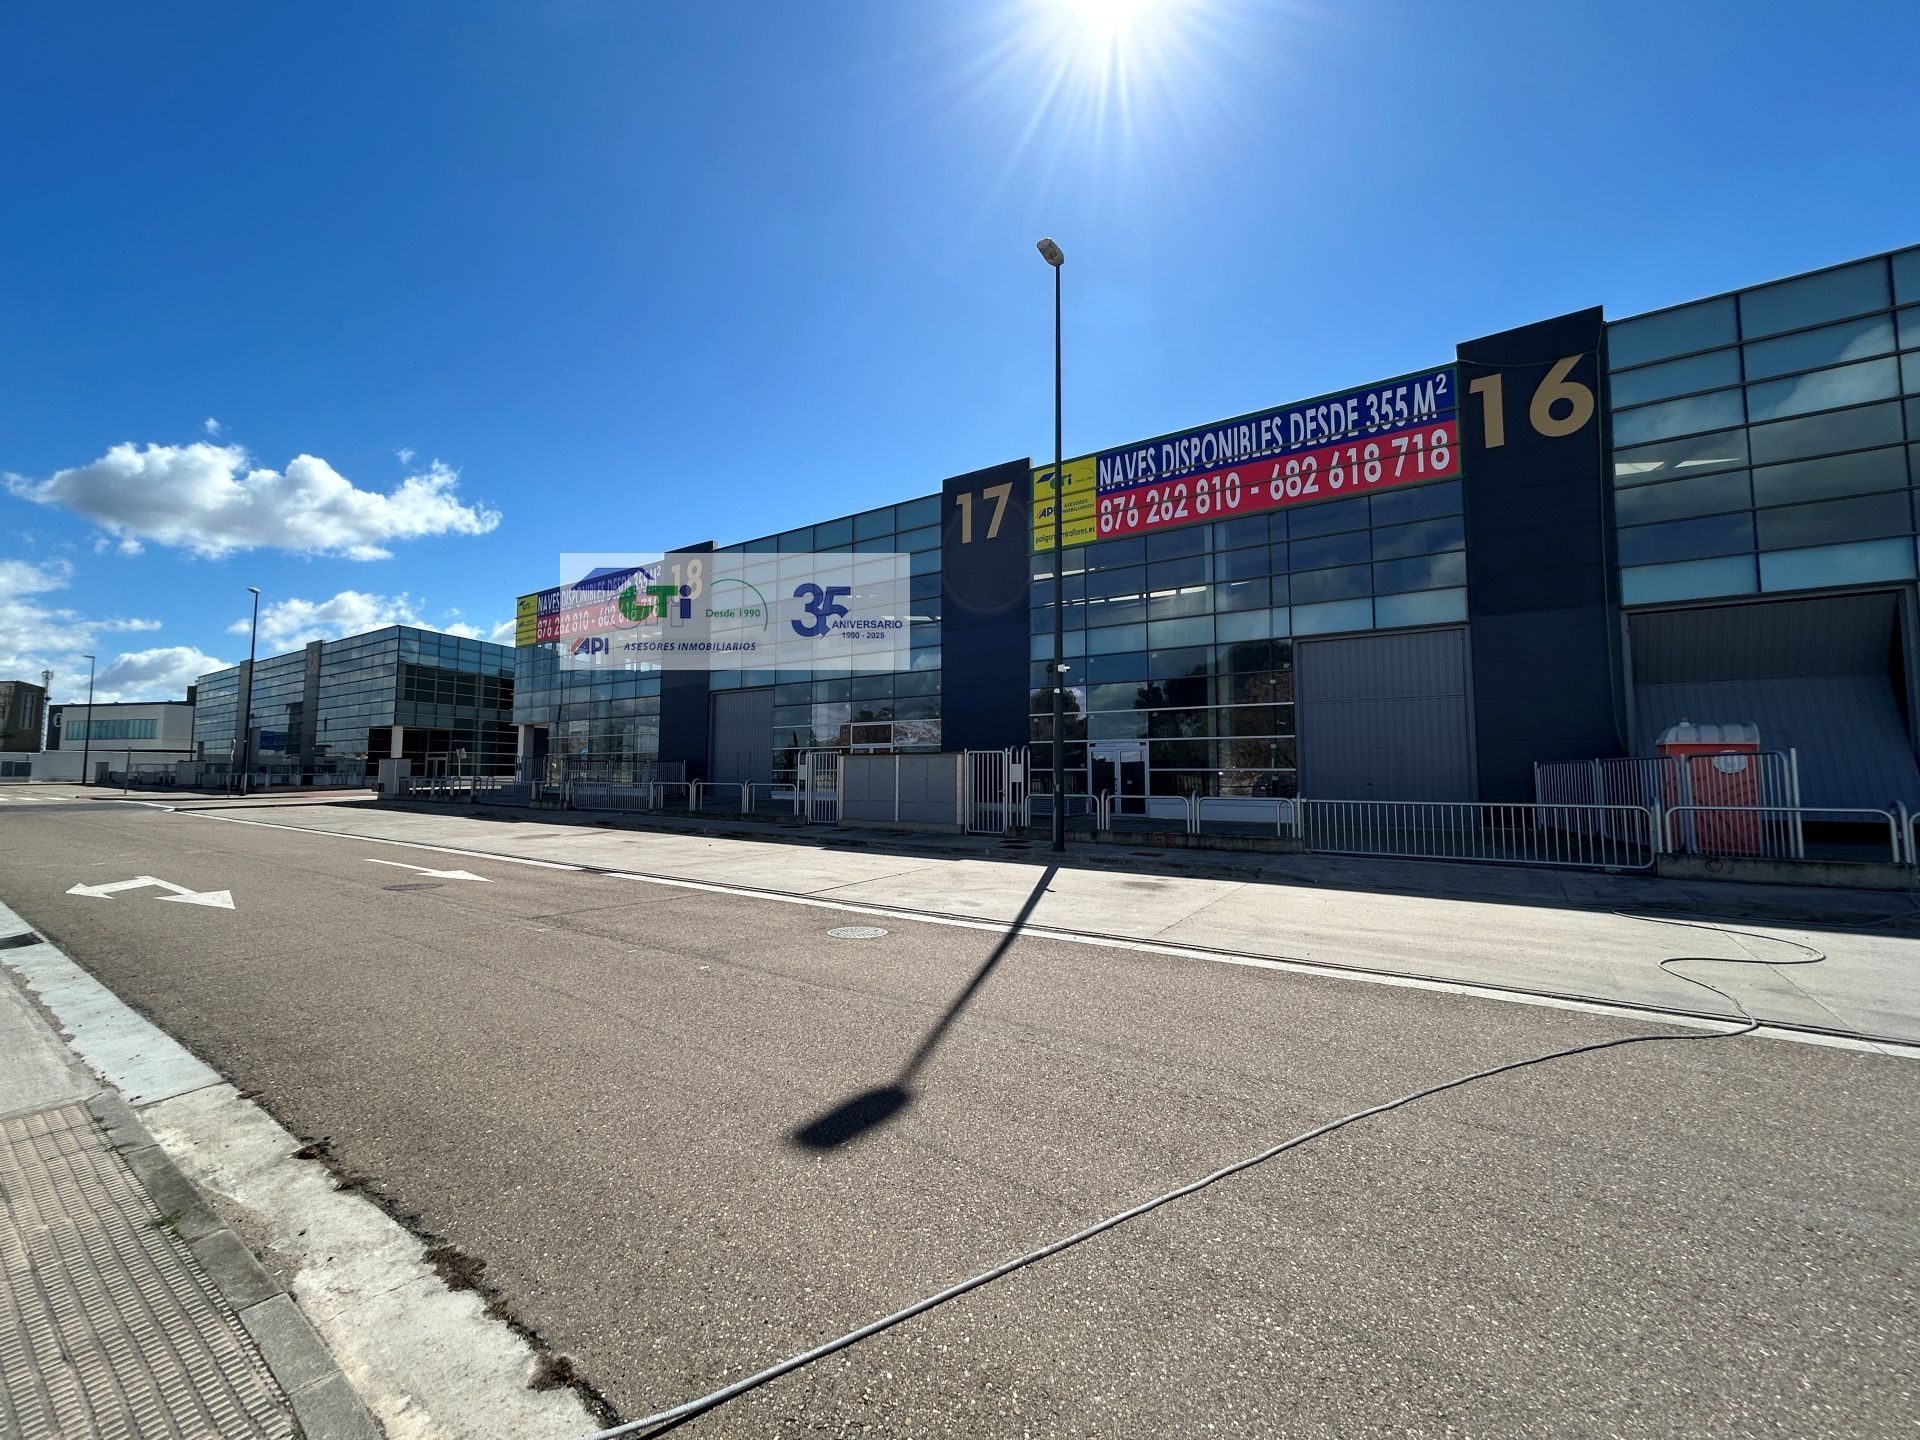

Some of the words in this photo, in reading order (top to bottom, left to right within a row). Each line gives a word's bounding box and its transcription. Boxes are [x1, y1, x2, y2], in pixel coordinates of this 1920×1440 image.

[1469, 353, 1595, 449] 16
[1099, 447, 1156, 491] NAVES
[1162, 416, 1283, 478] DISPONIBLES
[1290, 398, 1359, 450] DESDE
[1366, 386, 1408, 433] 355
[1100, 493, 1139, 533] 876
[1146, 483, 1188, 524] 262
[1195, 472, 1241, 514] 810
[1269, 456, 1319, 500] 682
[1328, 443, 1382, 489] 618
[1391, 429, 1450, 477] 718
[955, 482, 1013, 544] 17
[1062, 503, 1095, 513] MOBILIARIOS
[538, 591, 560, 615] NAVES
[671, 558, 702, 603] 18
[537, 618, 552, 639] 876
[554, 613, 570, 636] 262
[572, 610, 589, 632] 810
